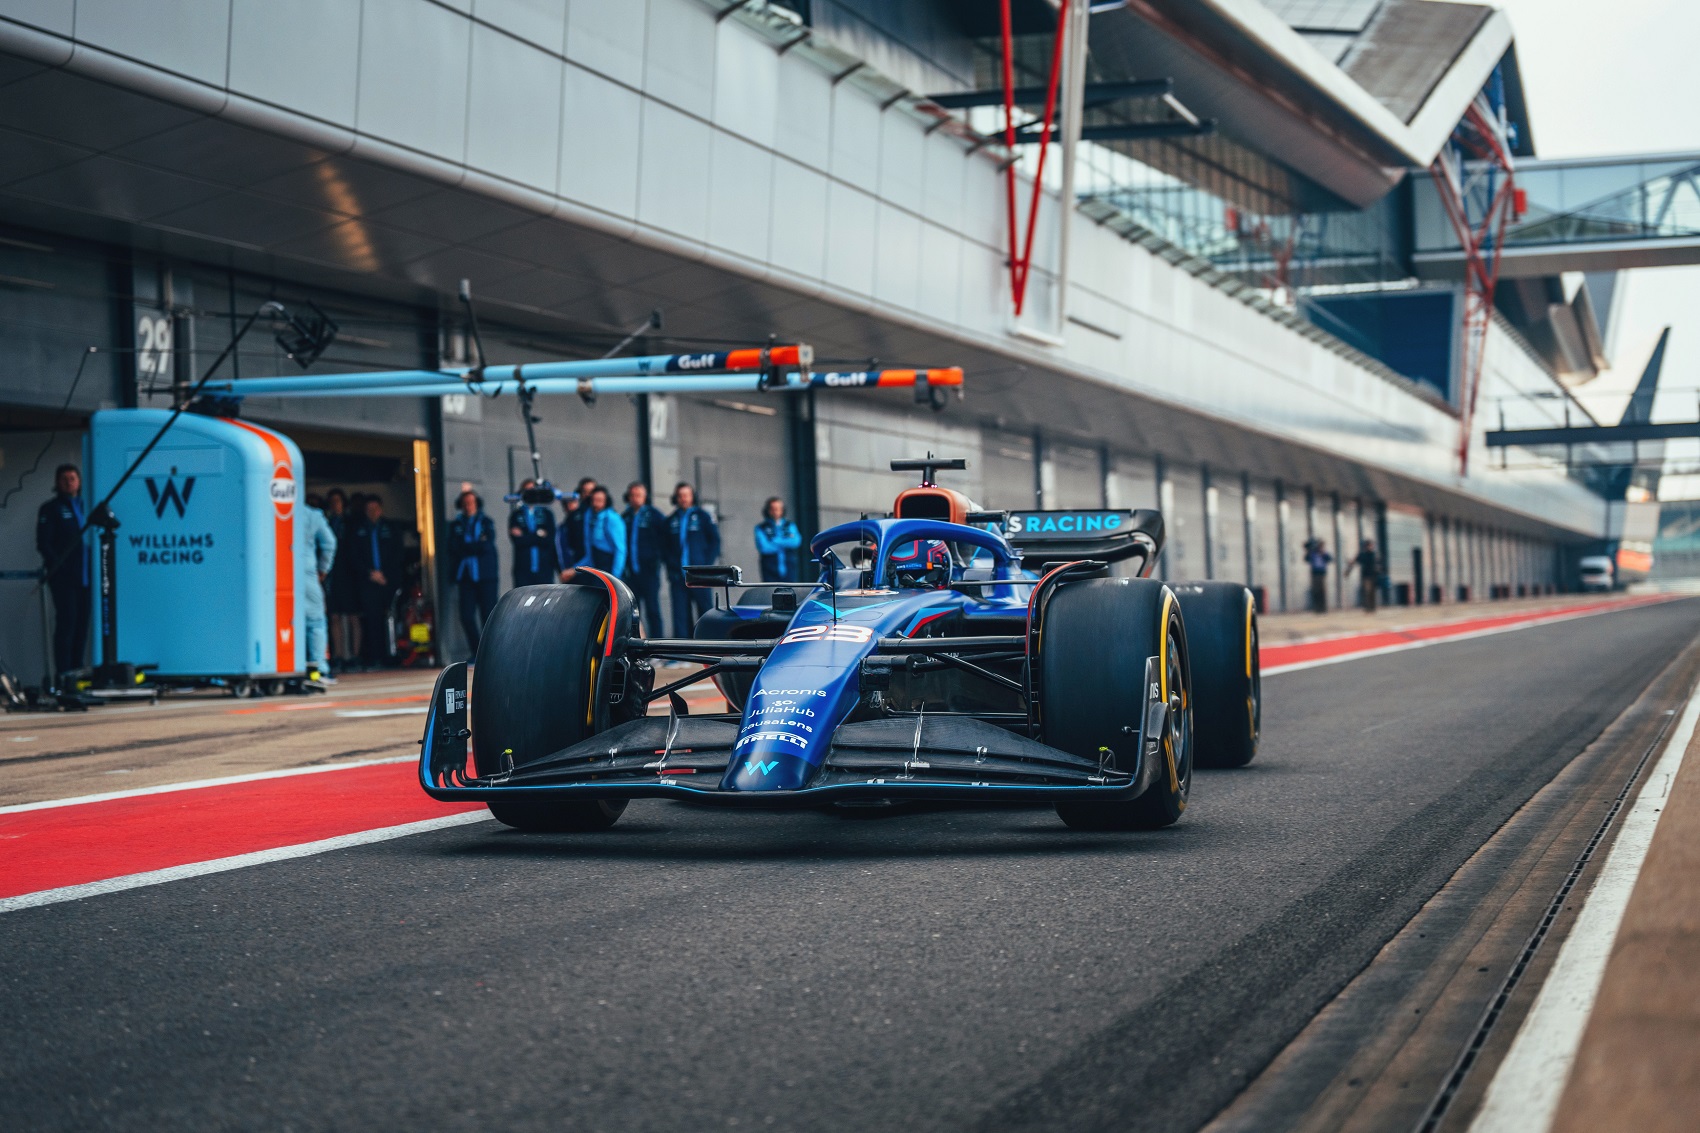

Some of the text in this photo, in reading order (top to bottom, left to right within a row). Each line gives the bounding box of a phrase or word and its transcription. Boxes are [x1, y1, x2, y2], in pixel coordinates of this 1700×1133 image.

[138, 315, 170, 374] 29
[677, 353, 715, 370] Gulf
[824, 371, 868, 387] Gulf
[271, 482, 295, 499] Gulf
[1026, 515, 1121, 533] RACING
[129, 534, 214, 548] WILLIAMS
[138, 551, 204, 565] RACING
[780, 624, 874, 645] 23
[753, 688, 827, 698] Acronis
[748, 706, 816, 718] JuliaHub
[741, 718, 813, 733] causaLens
